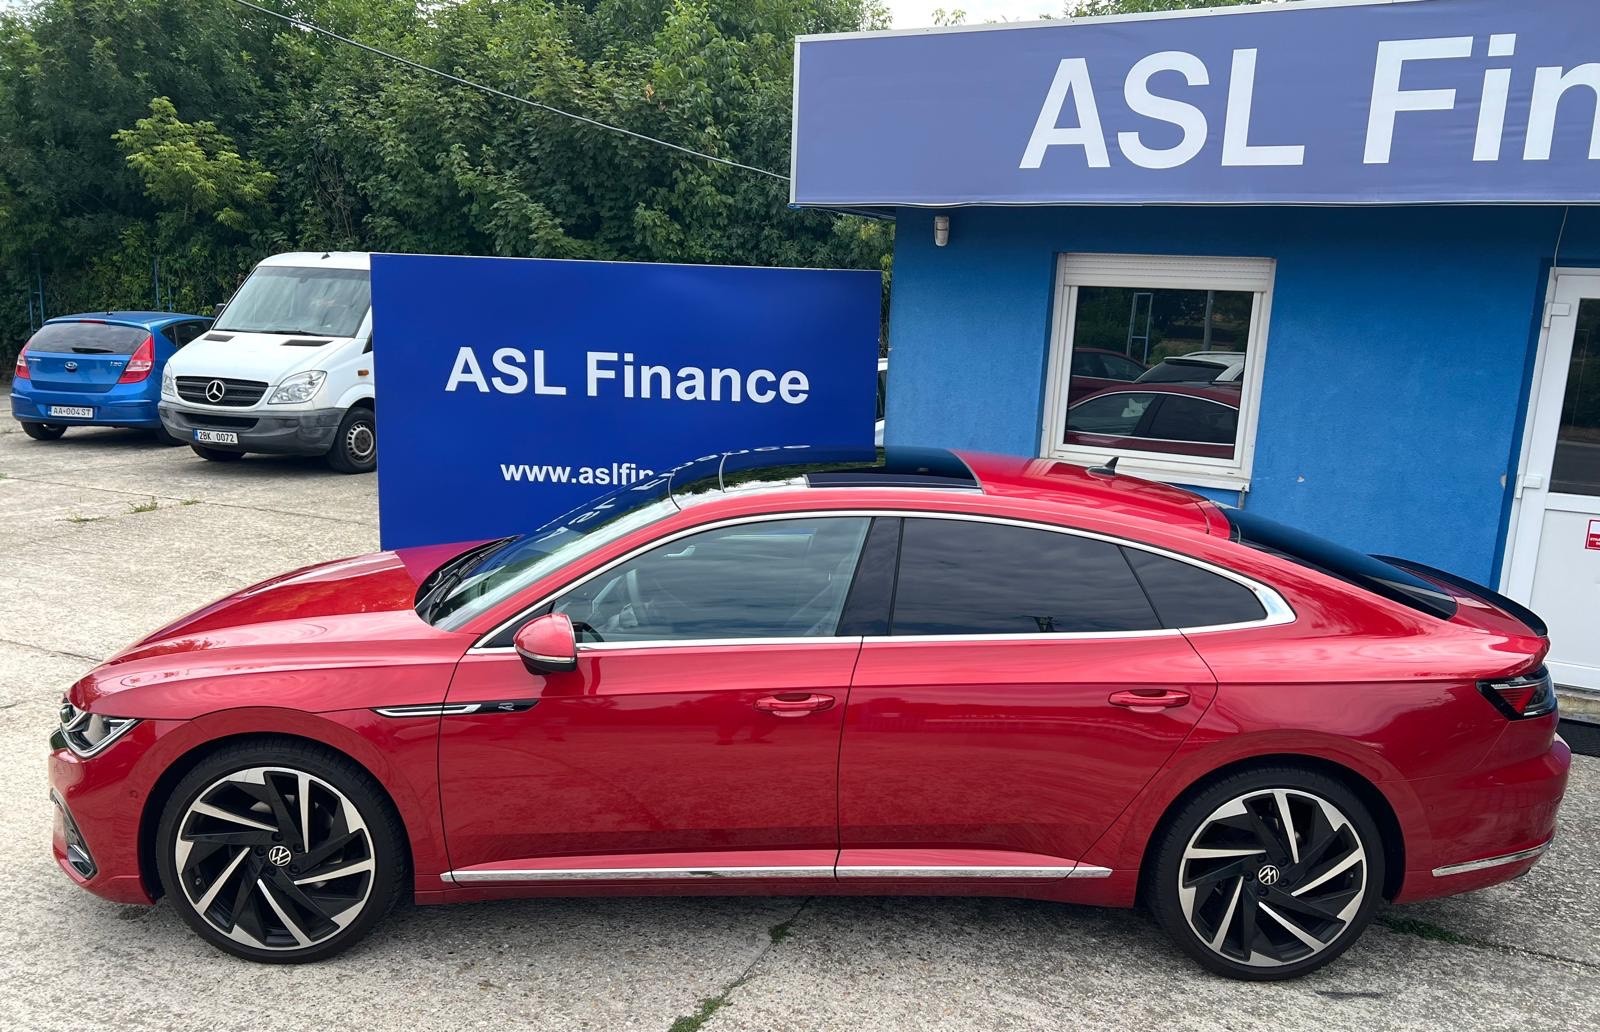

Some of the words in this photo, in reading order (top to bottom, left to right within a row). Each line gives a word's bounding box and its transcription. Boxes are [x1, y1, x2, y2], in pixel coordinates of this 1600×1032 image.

[1019, 48, 1305, 169] ASL
[1363, 33, 1600, 165] Fin
[445, 346, 567, 396] ASL
[587, 351, 810, 404] Finance
[199, 431, 211, 440] 2BK
[216, 433, 234, 443] 0072
